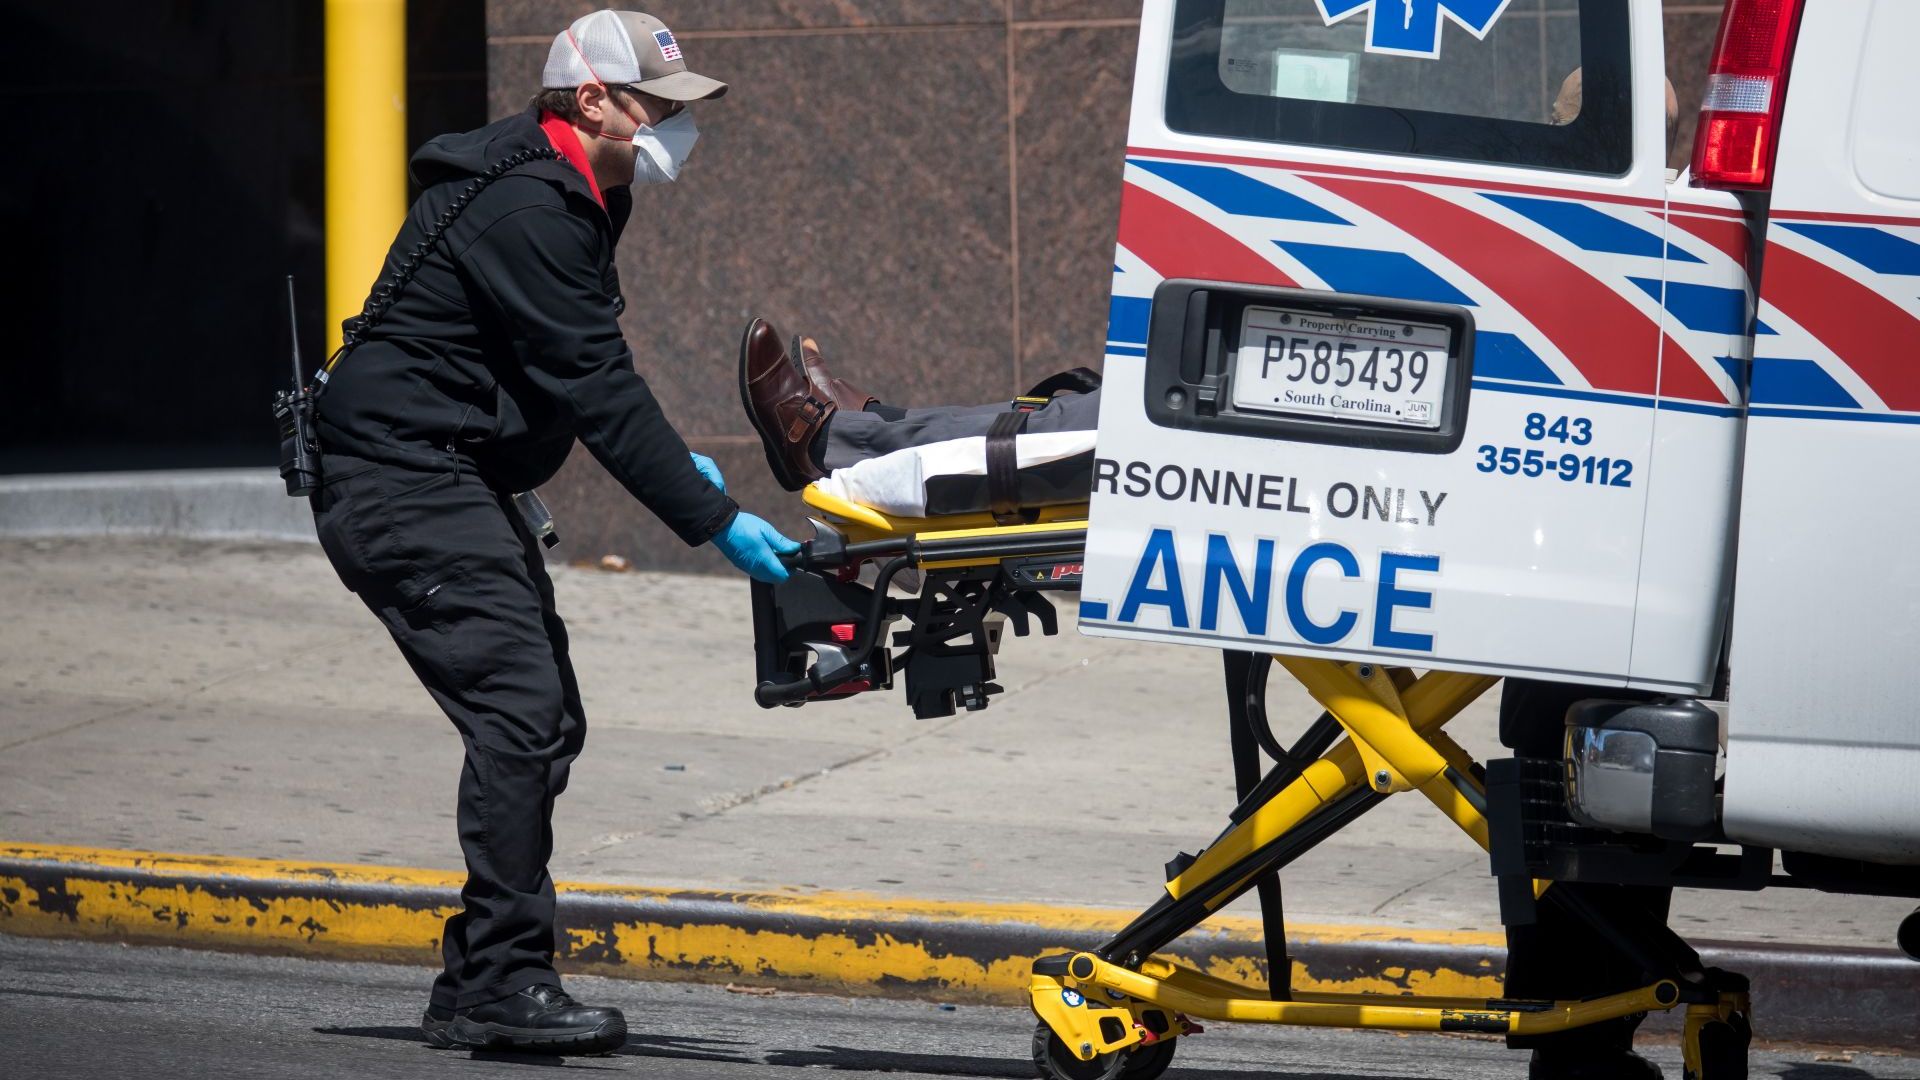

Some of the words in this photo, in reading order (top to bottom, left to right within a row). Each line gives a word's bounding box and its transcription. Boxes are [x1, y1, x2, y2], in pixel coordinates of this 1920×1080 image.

[1300, 317, 1345, 334] Property
[1348, 322, 1396, 339] Carrying
[1261, 334, 1428, 395] P585439
[1284, 389, 1326, 406] South
[1330, 394, 1392, 414] Carolina
[1407, 402, 1428, 412] JUN
[1523, 412, 1593, 446] 843
[1475, 444, 1633, 488] 355-9112
[1091, 457, 1311, 514] RSONNEL
[1326, 481, 1449, 527] ONLY
